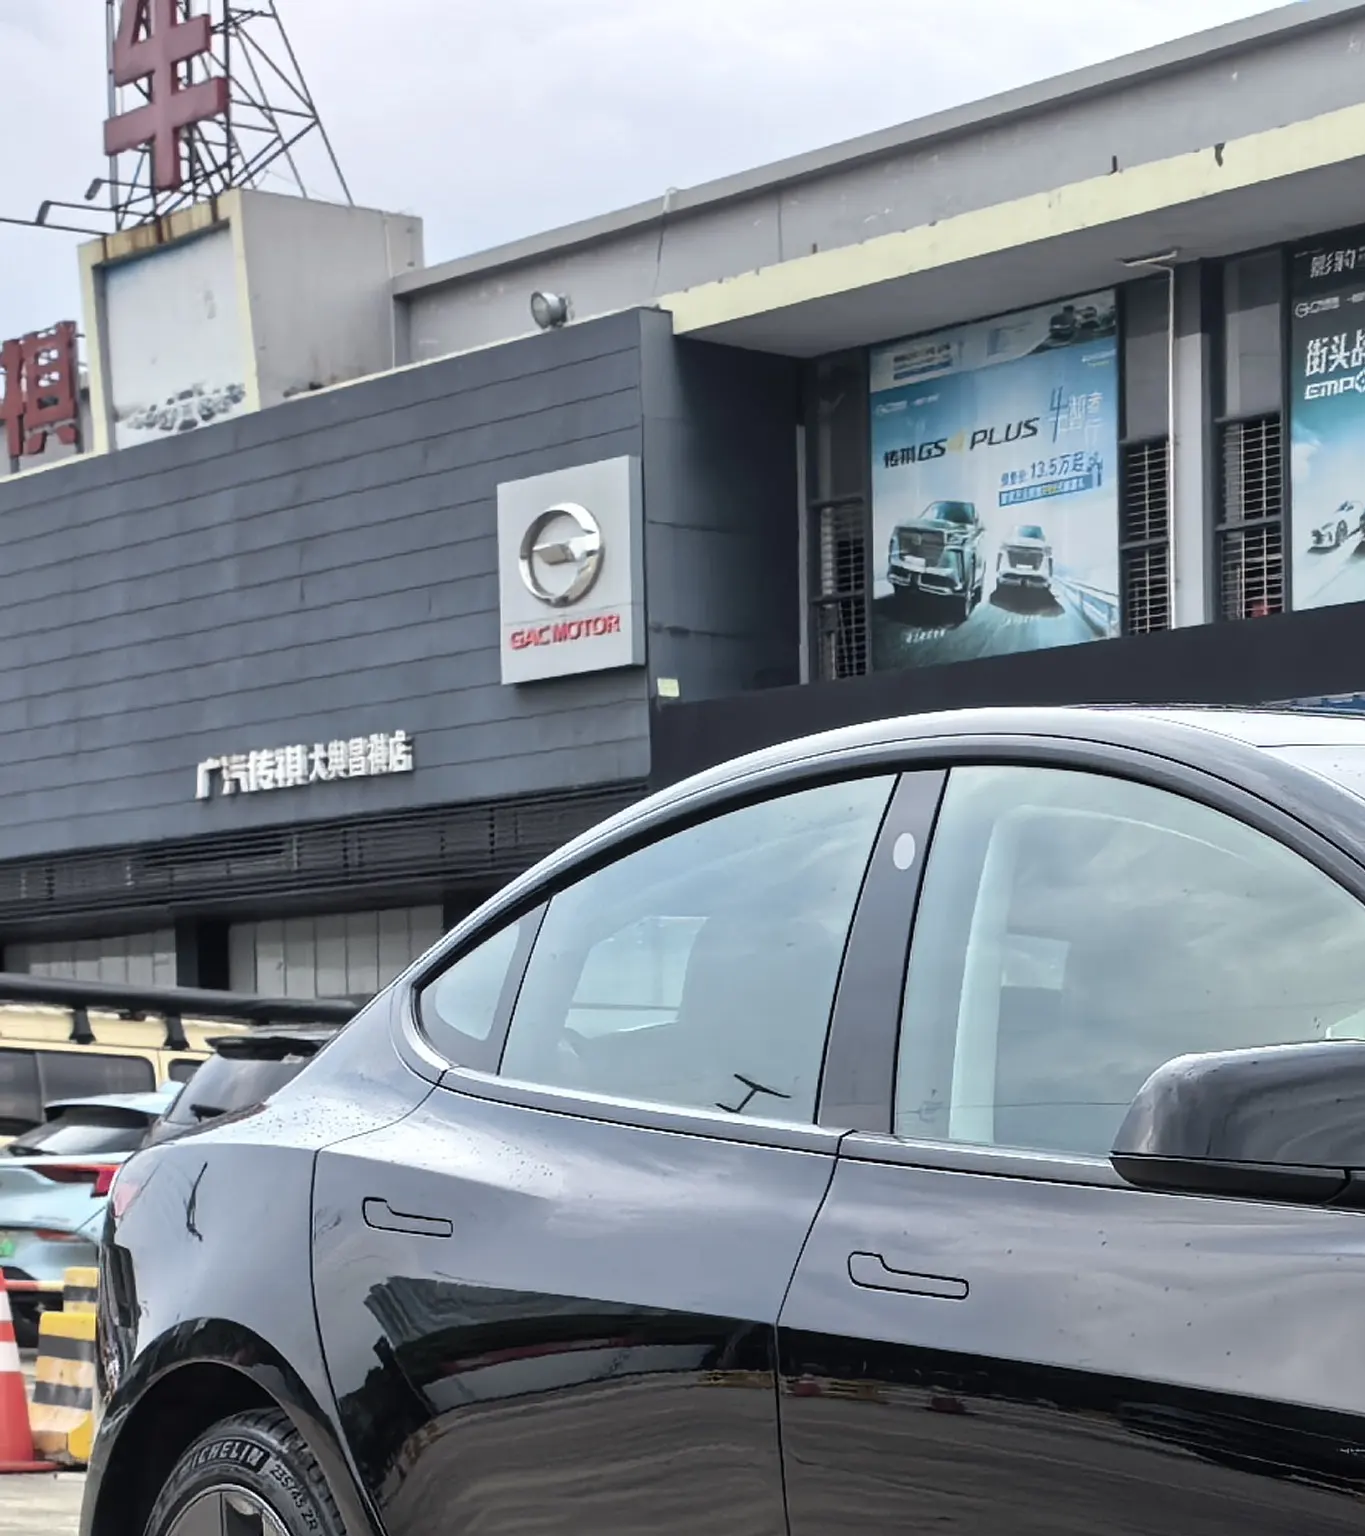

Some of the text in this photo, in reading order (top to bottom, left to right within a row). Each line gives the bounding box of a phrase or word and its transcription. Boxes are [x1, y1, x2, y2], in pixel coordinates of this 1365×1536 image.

[970, 417, 1040, 450] PLUS
[510, 615, 622, 651] GAC MOTOR
